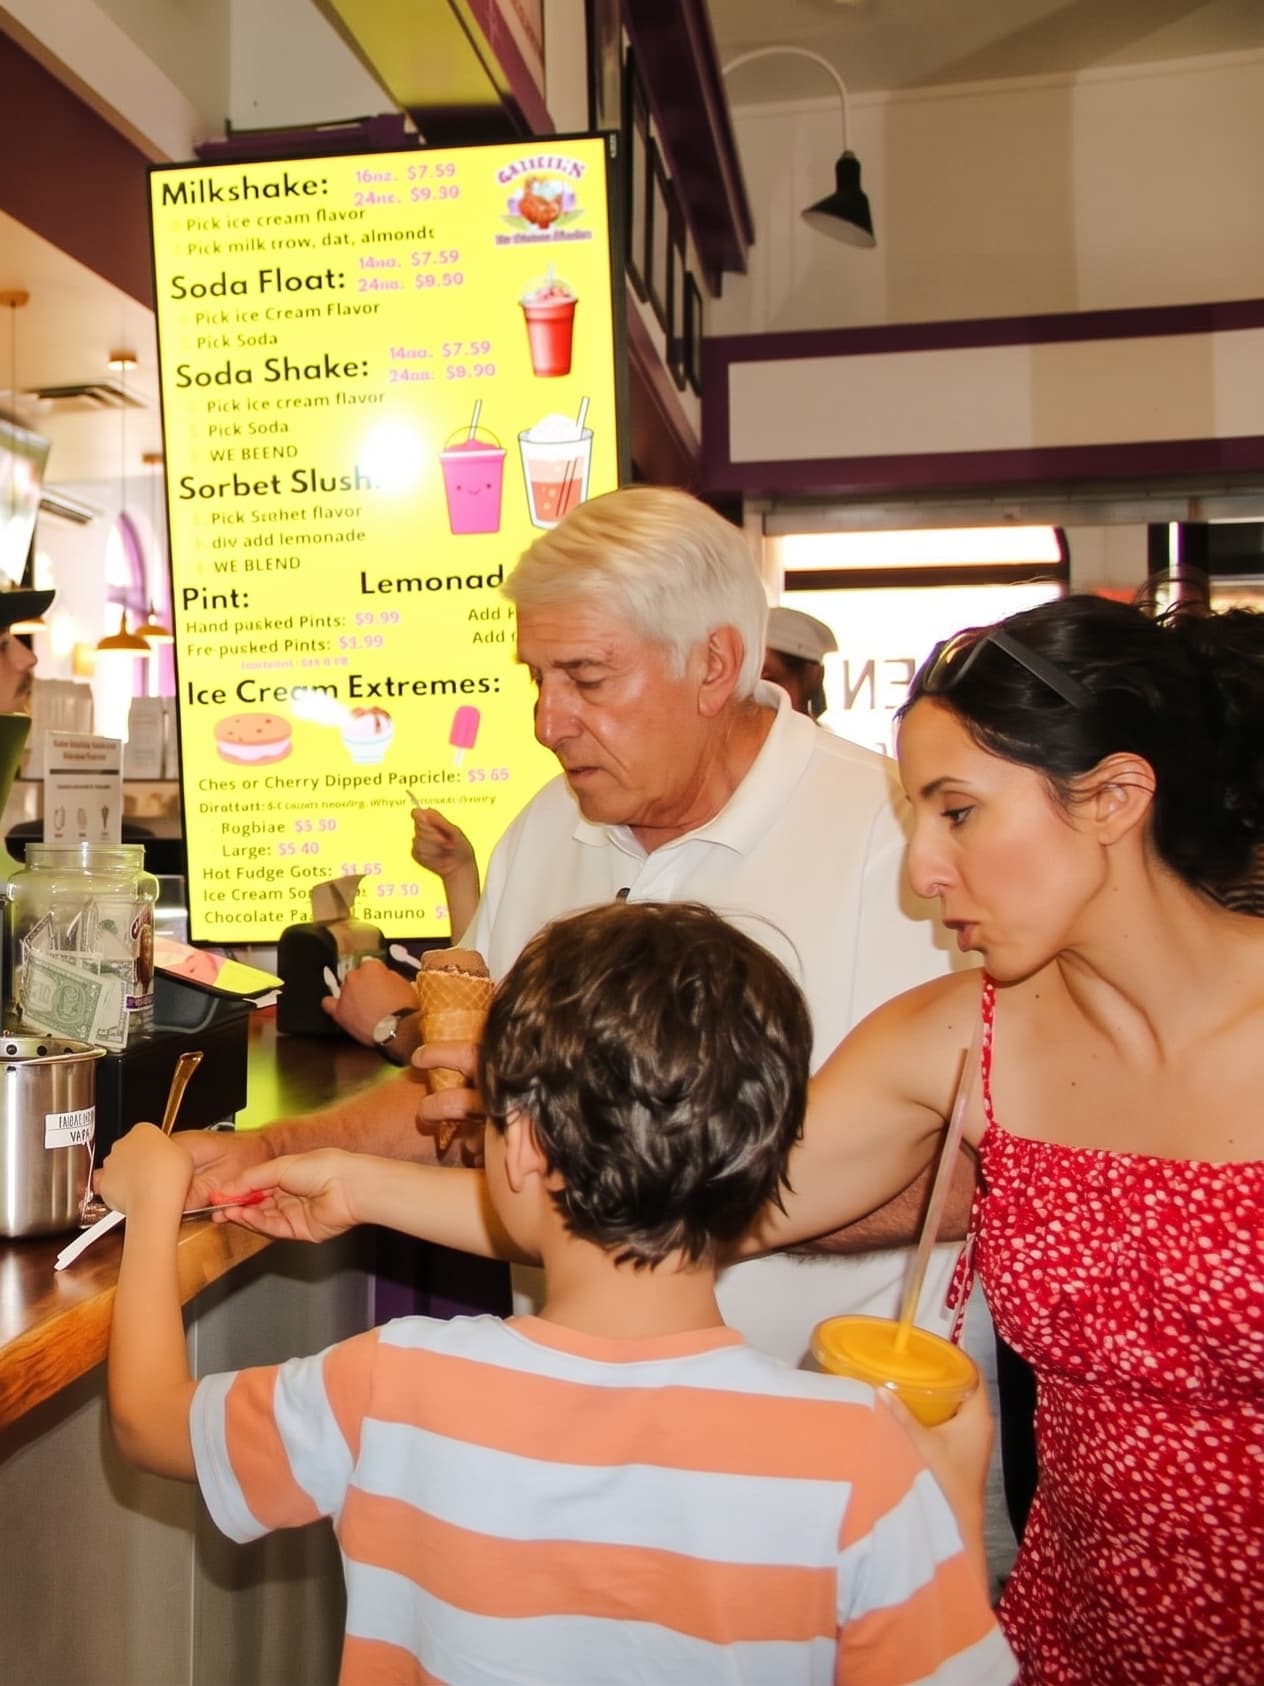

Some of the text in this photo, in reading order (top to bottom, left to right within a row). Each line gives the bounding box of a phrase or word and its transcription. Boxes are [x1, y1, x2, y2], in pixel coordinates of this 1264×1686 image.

[407, 163, 456, 180] $7.59
[162, 172, 328, 206] Milkshake:
[187, 208, 366, 231] Pick ice cream flavor
[188, 240, 221, 255] Pick
[229, 237, 264, 253] milk
[411, 250, 459, 267] $7.59
[171, 267, 345, 299] Soda Float:
[195, 301, 381, 325] Pick ice Cream Flavor
[197, 332, 278, 349] Pick Soda
[442, 341, 491, 358] $7.59
[176, 353, 368, 388] Soda Shake:
[207, 391, 385, 413] Pick ice cream flavor
[209, 420, 288, 437] Pick Soda
[210, 449, 236, 462] WE
[179, 473, 280, 500] Sorbet
[212, 511, 244, 525] Pick
[313, 505, 362, 520] flavor
[243, 533, 273, 547] add
[280, 528, 366, 546] lemonade
[214, 556, 301, 574] WE BLEND
[361, 564, 503, 594] Lemonad
[182, 587, 249, 611] Pint:
[468, 607, 501, 622] Add
[186, 619, 228, 634] Hand
[300, 614, 346, 629] Pints:
[285, 637, 331, 653] Pints:
[472, 630, 505, 645] Add
[189, 682, 226, 705] Ice
[349, 674, 500, 699] Extremes:
[198, 778, 236, 792] Ches
[242, 779, 259, 790] or
[265, 776, 319, 792] Cherry
[325, 772, 382, 790] Dipped
[389, 770, 461, 788] Papcicle:
[222, 845, 271, 860] Large:
[203, 867, 232, 880] Hot
[236, 866, 284, 882] Fudge
[290, 865, 332, 878] Gots:
[203, 889, 225, 902] Ice
[232, 888, 283, 902] Cream
[204, 909, 284, 924] Chocolate
